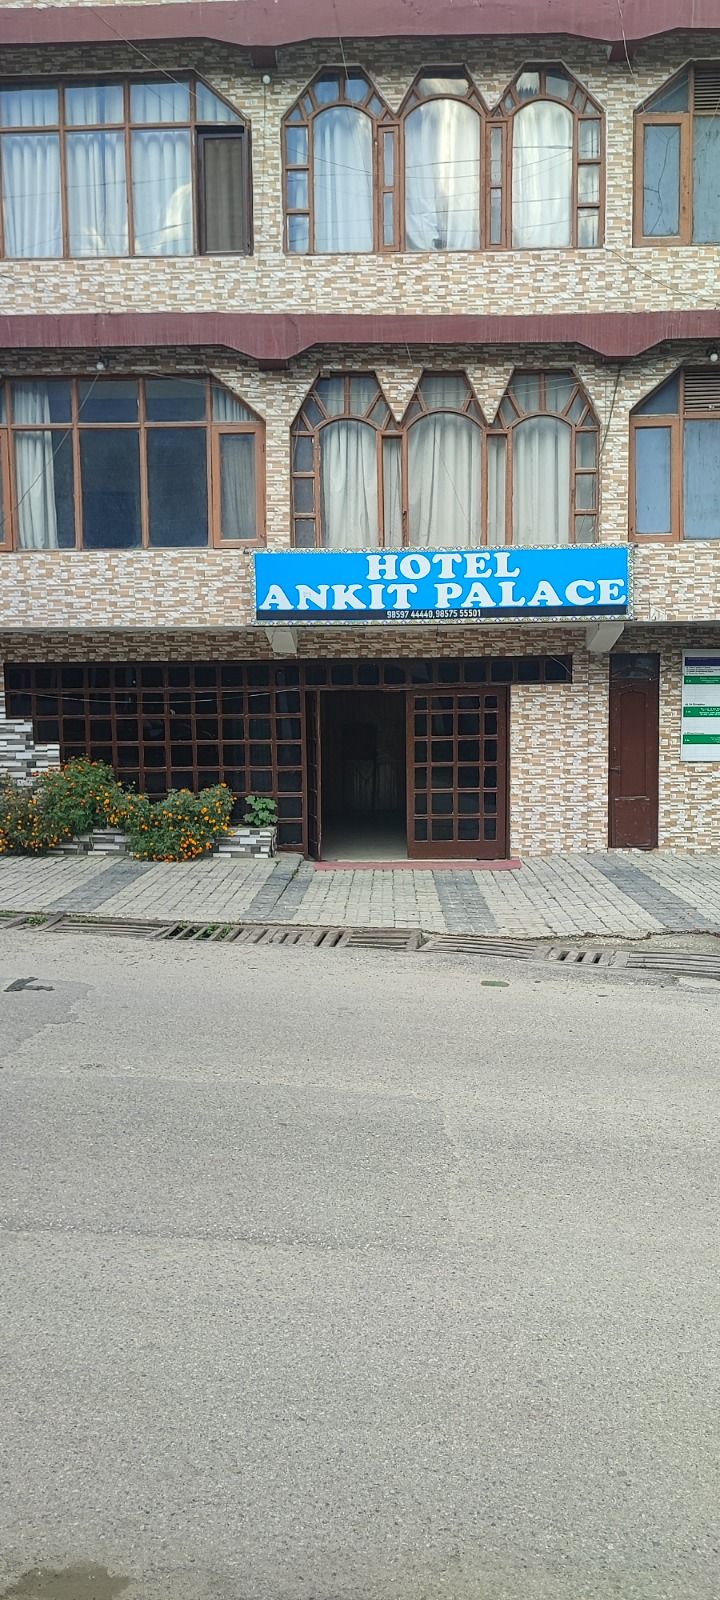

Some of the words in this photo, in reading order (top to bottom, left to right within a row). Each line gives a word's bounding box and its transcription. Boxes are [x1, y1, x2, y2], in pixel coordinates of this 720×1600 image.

[364, 551, 521, 581] HOTEL
[258, 583, 418, 611] ANKIT
[433, 579, 627, 609] PALACE
[386, 610, 409, 619] 98597
[459, 609, 481, 618] 55501
